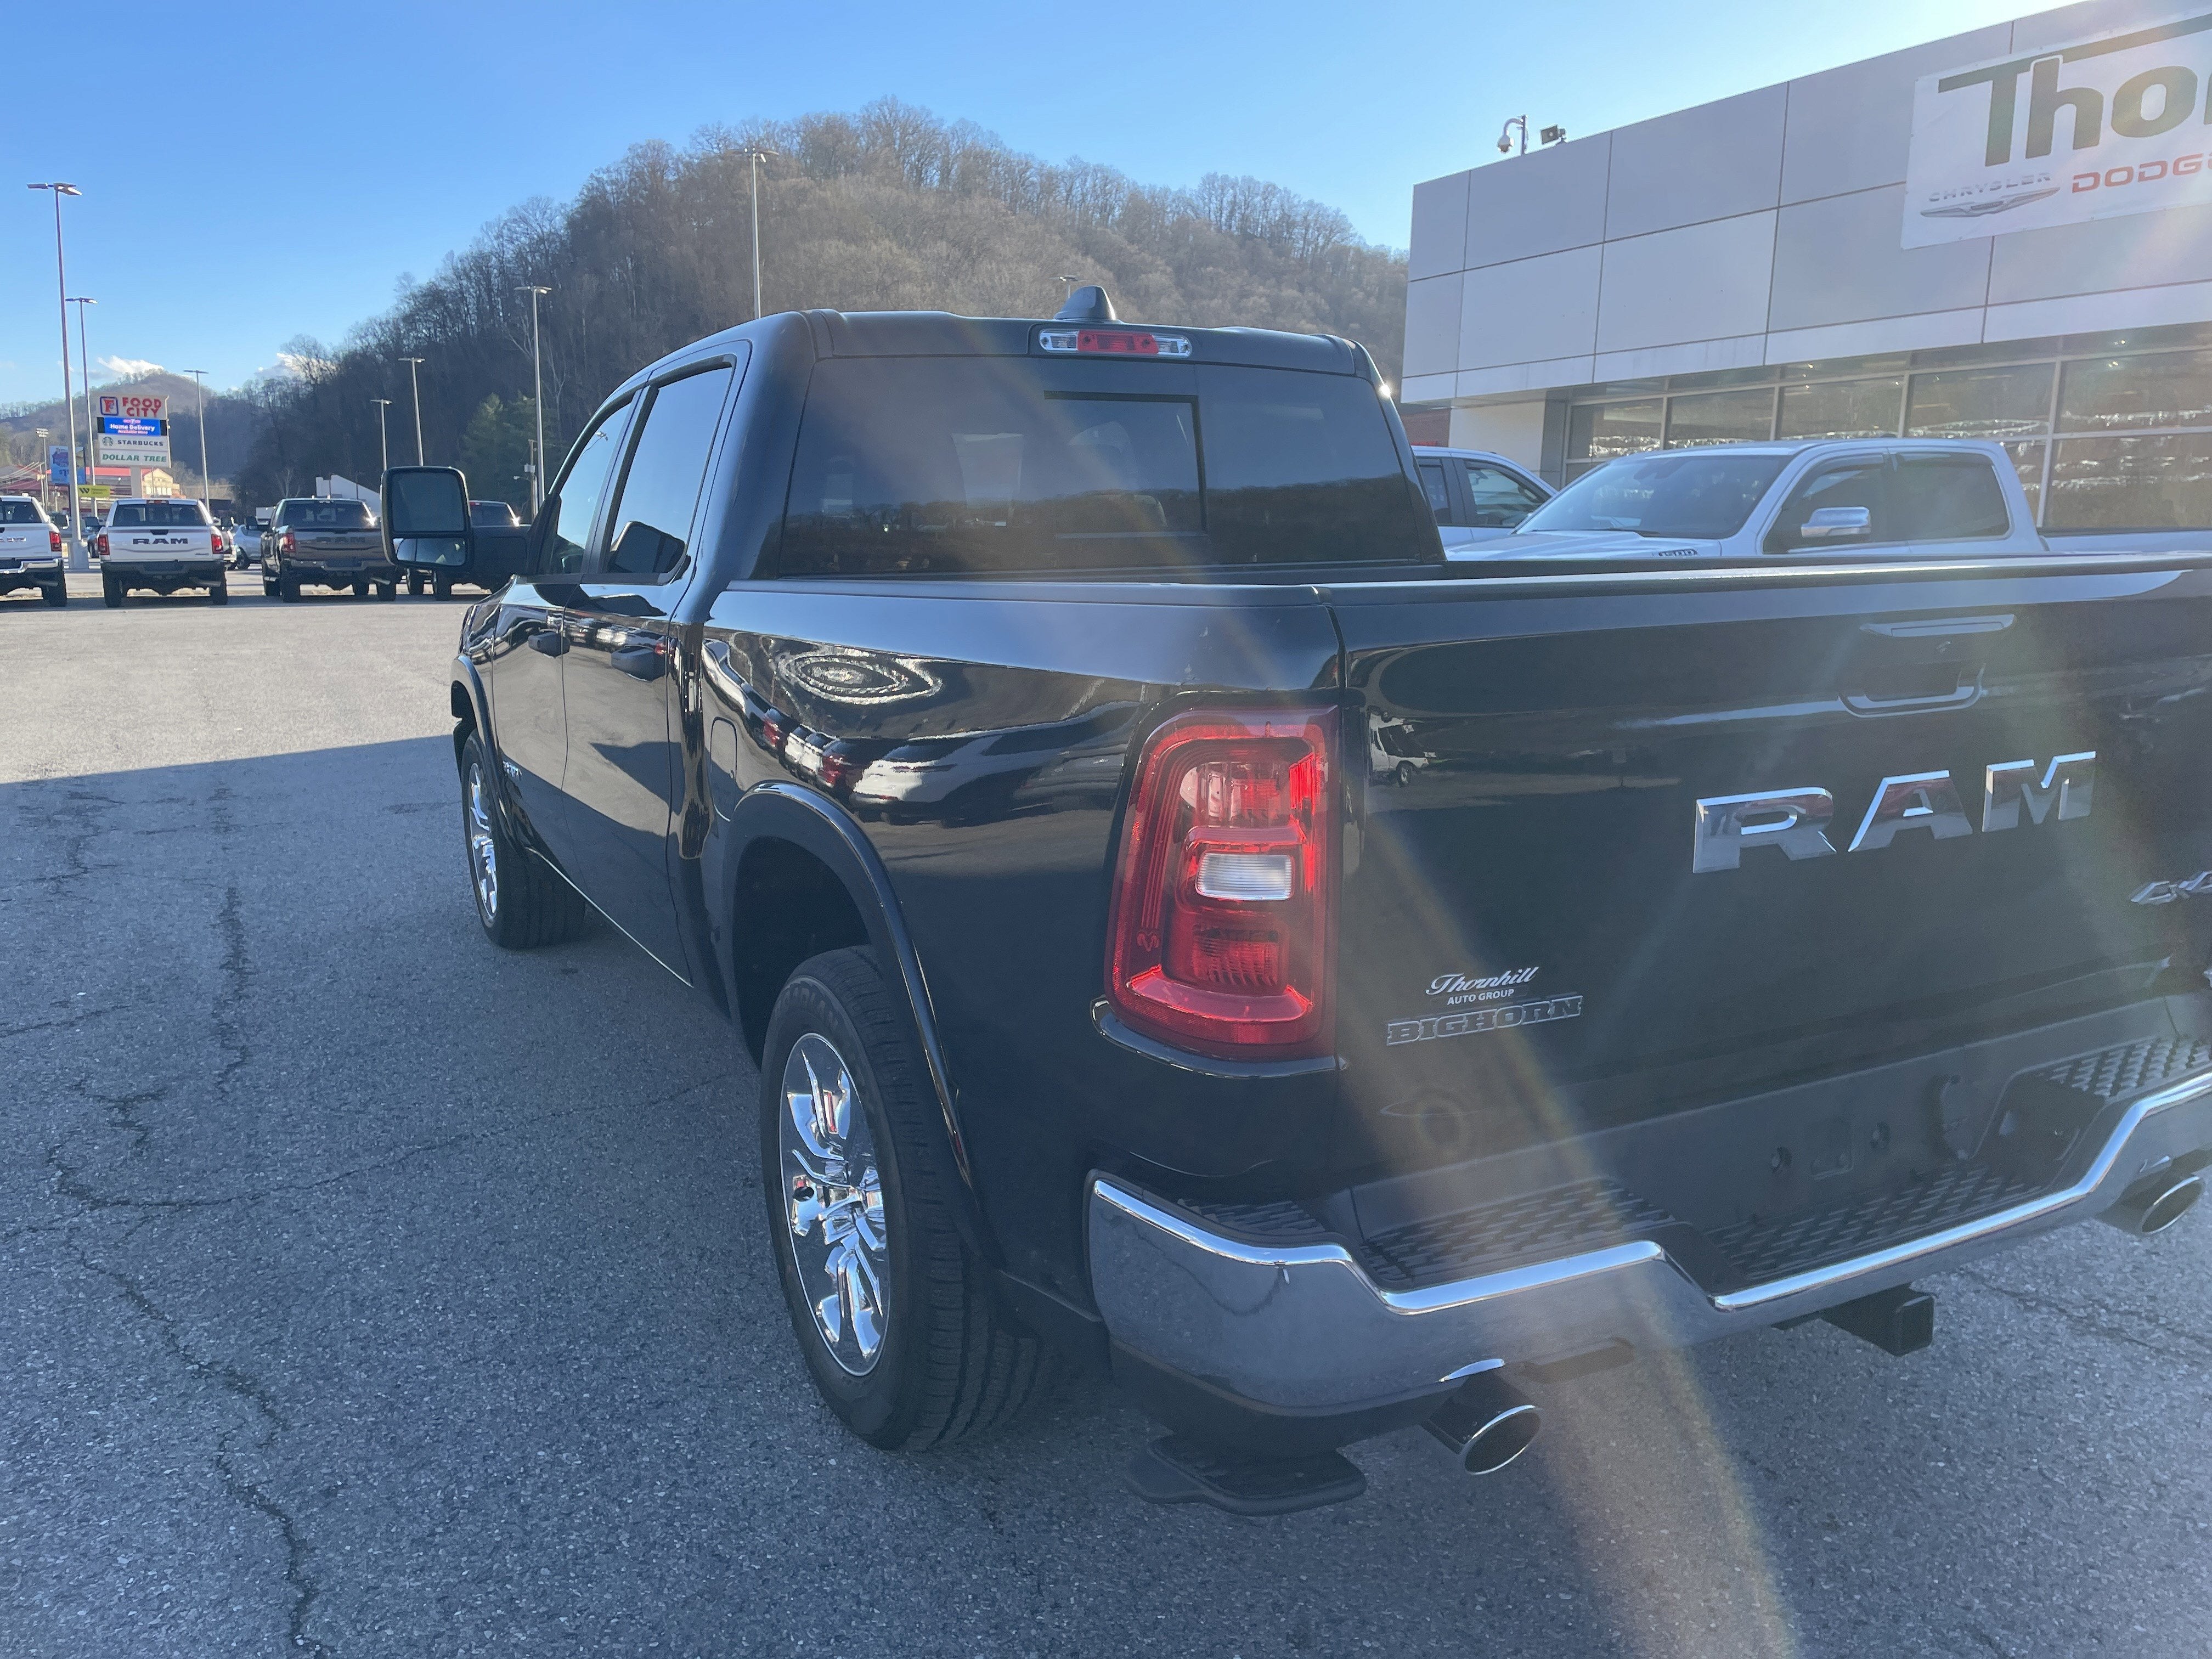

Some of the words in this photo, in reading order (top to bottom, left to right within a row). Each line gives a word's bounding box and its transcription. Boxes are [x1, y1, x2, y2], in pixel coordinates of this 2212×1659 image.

[1938, 14, 2212, 167] Tho
[1928, 172, 2051, 202] CHRYSLER
[122, 397, 162, 408] FOOD
[126, 407, 160, 417] CITY
[129, 424, 155, 432] Delivery
[1692, 750, 2096, 873] RAM
[1425, 967, 1539, 995] Thornhill
[1447, 994, 1476, 1006] AUTO
[1478, 989, 1515, 1001] GROUP
[1386, 995, 1583, 1046] BIGHORN
